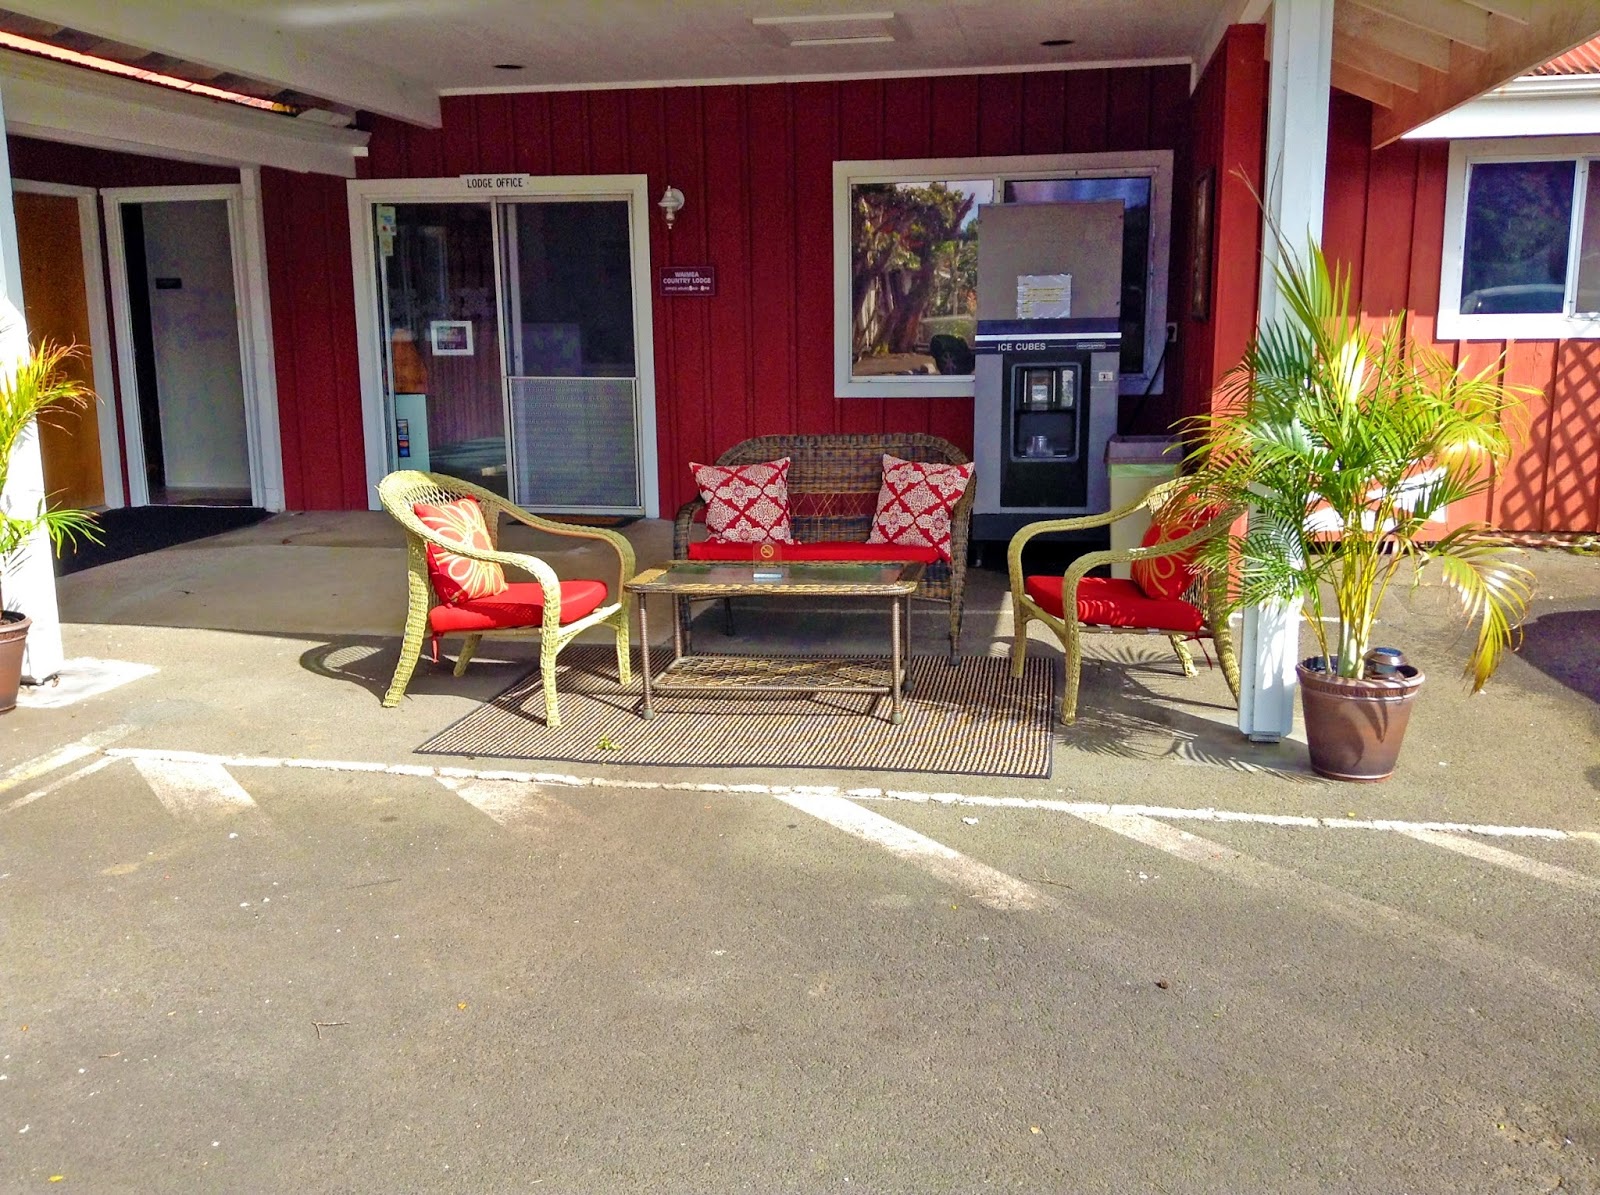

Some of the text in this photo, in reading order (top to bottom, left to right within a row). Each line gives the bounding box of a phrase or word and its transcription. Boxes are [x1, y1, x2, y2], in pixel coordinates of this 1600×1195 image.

[467, 178, 523, 188] LODGE OFFICE
[997, 342, 1046, 351] ICE CUBES
